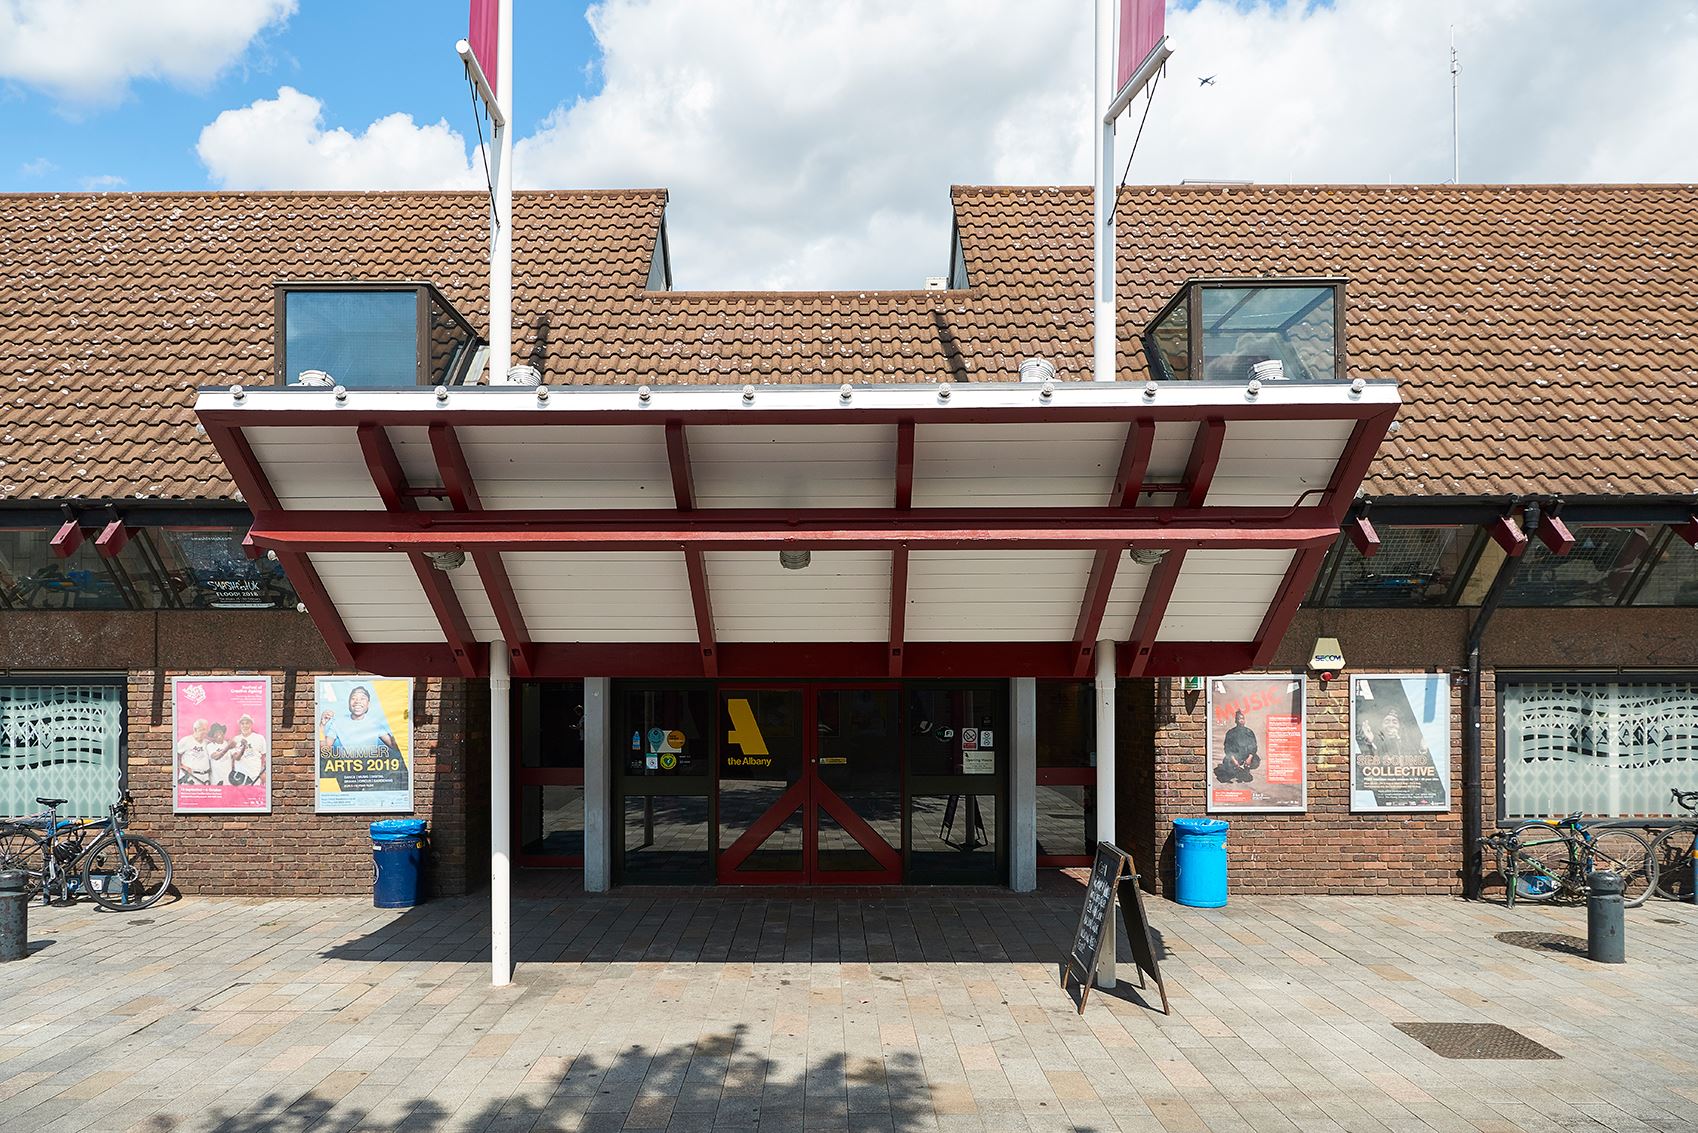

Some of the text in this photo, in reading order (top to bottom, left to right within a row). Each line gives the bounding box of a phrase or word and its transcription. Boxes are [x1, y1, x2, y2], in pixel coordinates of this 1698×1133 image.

[1315, 654, 1342, 662] SECOM
[1215, 685, 1281, 721] MUSIC
[320, 745, 389, 759] SUMMER
[324, 758, 400, 772] ARTS 2019
[727, 756, 772, 767] the Albany
[1362, 766, 1435, 777] COLLECTIVE
